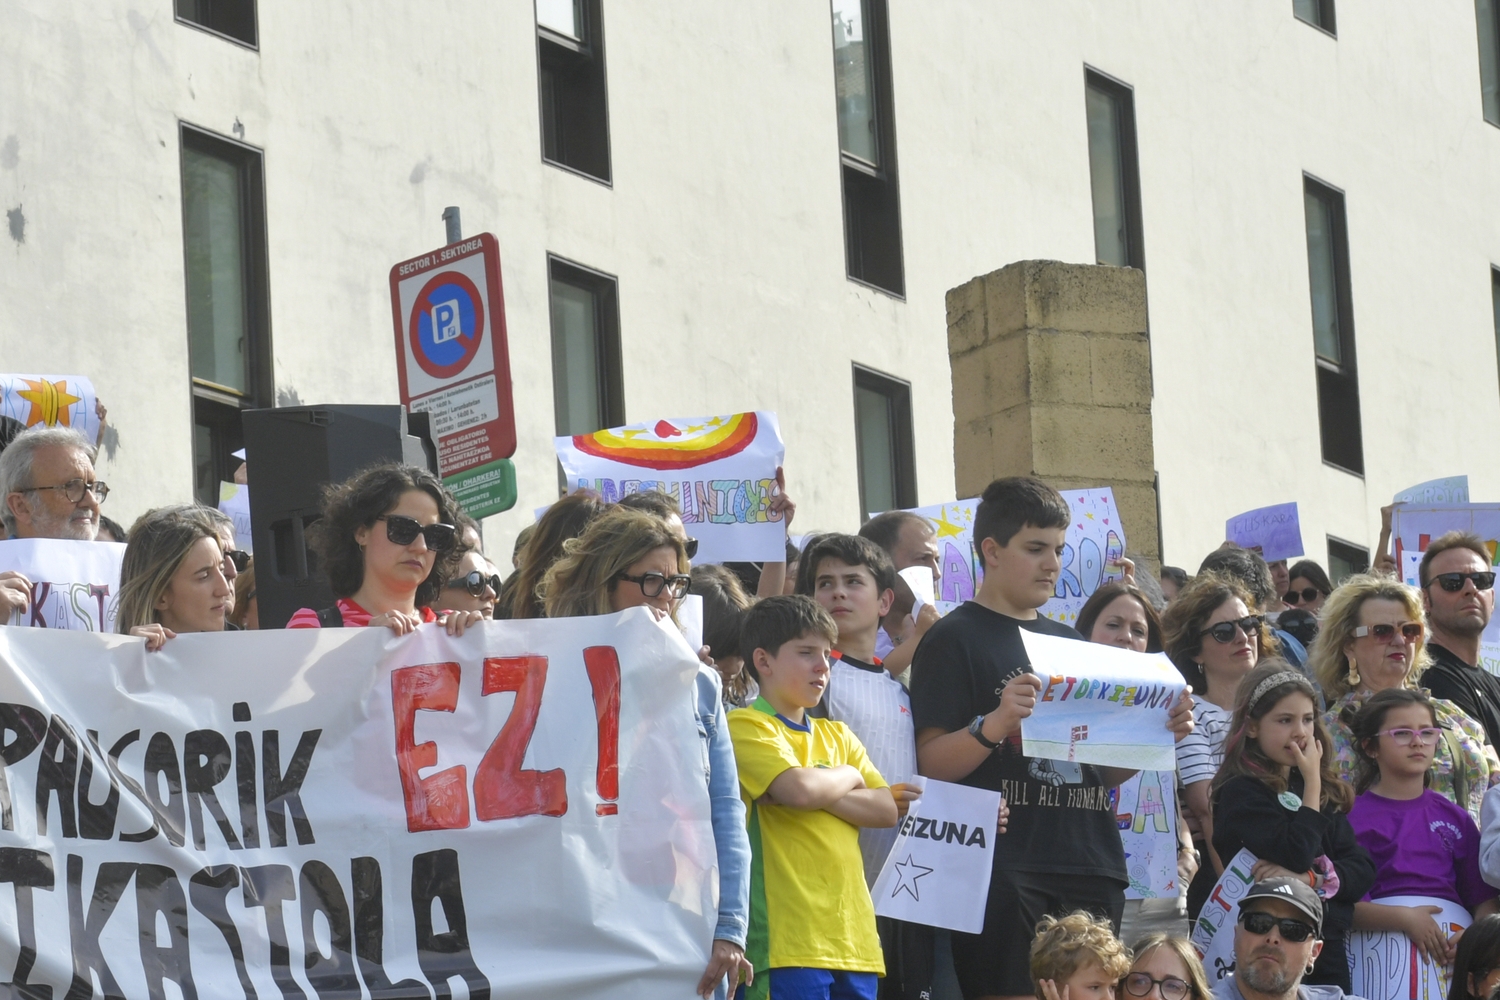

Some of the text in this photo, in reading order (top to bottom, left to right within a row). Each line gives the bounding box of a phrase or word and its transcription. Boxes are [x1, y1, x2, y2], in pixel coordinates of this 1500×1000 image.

[399, 257, 430, 276] SECTOR
[441, 238, 483, 261] SEKTOREA
[435, 304, 454, 340] P
[433, 408, 446, 418] bados
[447, 428, 486, 446] OBLIGATORIO
[452, 435, 488, 452] RESIDENTES
[440, 451, 491, 474] AGUNENTZAT ERE
[448, 444, 489, 463] NAHITAEZKOA
[391, 645, 621, 833] EZ!
[1038, 784, 1060, 807] ALL
